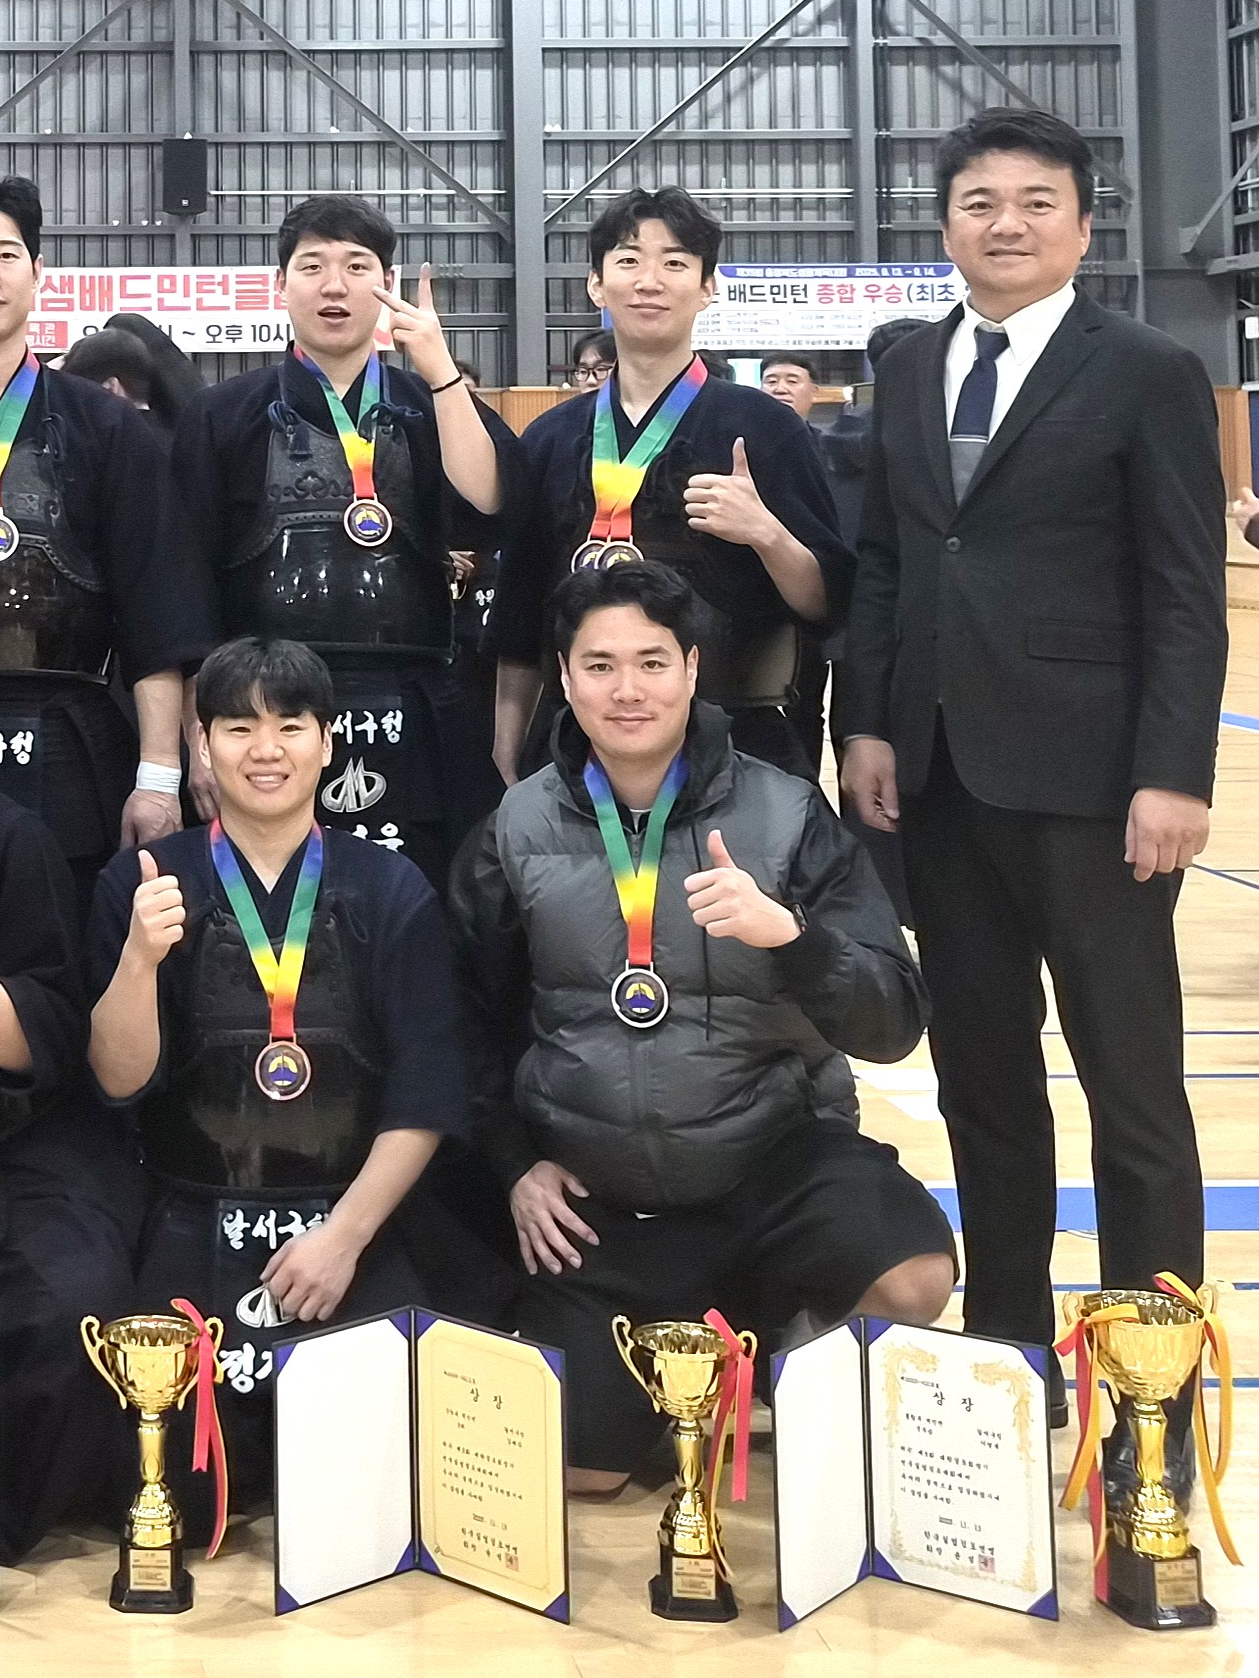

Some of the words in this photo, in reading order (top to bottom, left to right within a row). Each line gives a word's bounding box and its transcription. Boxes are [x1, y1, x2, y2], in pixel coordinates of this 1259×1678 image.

[29, 274, 287, 312] 샘배드민턴클
[727, 283, 809, 304] 배드민턴
[816, 283, 856, 304] 종합
[206, 324, 243, 344] 오후
[251, 323, 291, 343] 10시
[331, 709, 404, 744] 서구청
[933, 1391, 945, 1406] 상
[961, 1397, 974, 1412] 장
